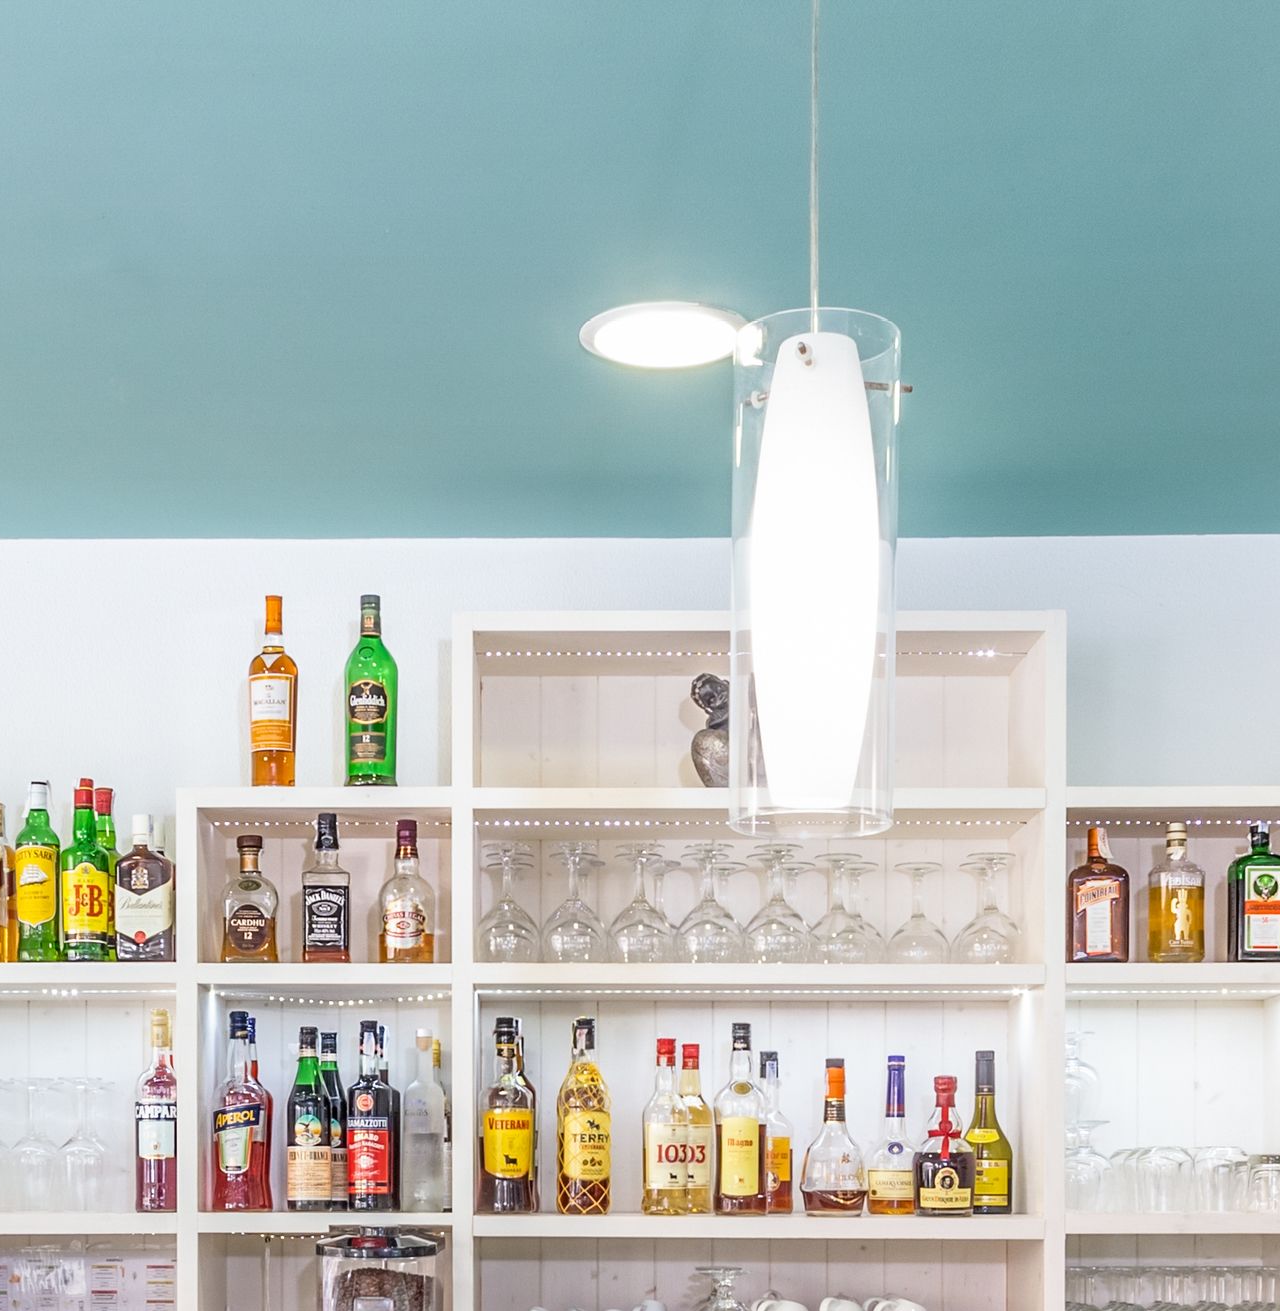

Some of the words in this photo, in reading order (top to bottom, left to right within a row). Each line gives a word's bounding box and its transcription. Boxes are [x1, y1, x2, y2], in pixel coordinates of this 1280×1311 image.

[230, 918, 265, 927] CARDHU
[243, 931, 253, 940] 12
[136, 1105, 177, 1119] CAMPAR
[215, 1110, 256, 1129] APEROL
[571, 1133, 610, 1143] TERRY
[657, 1144, 687, 1163] 103
